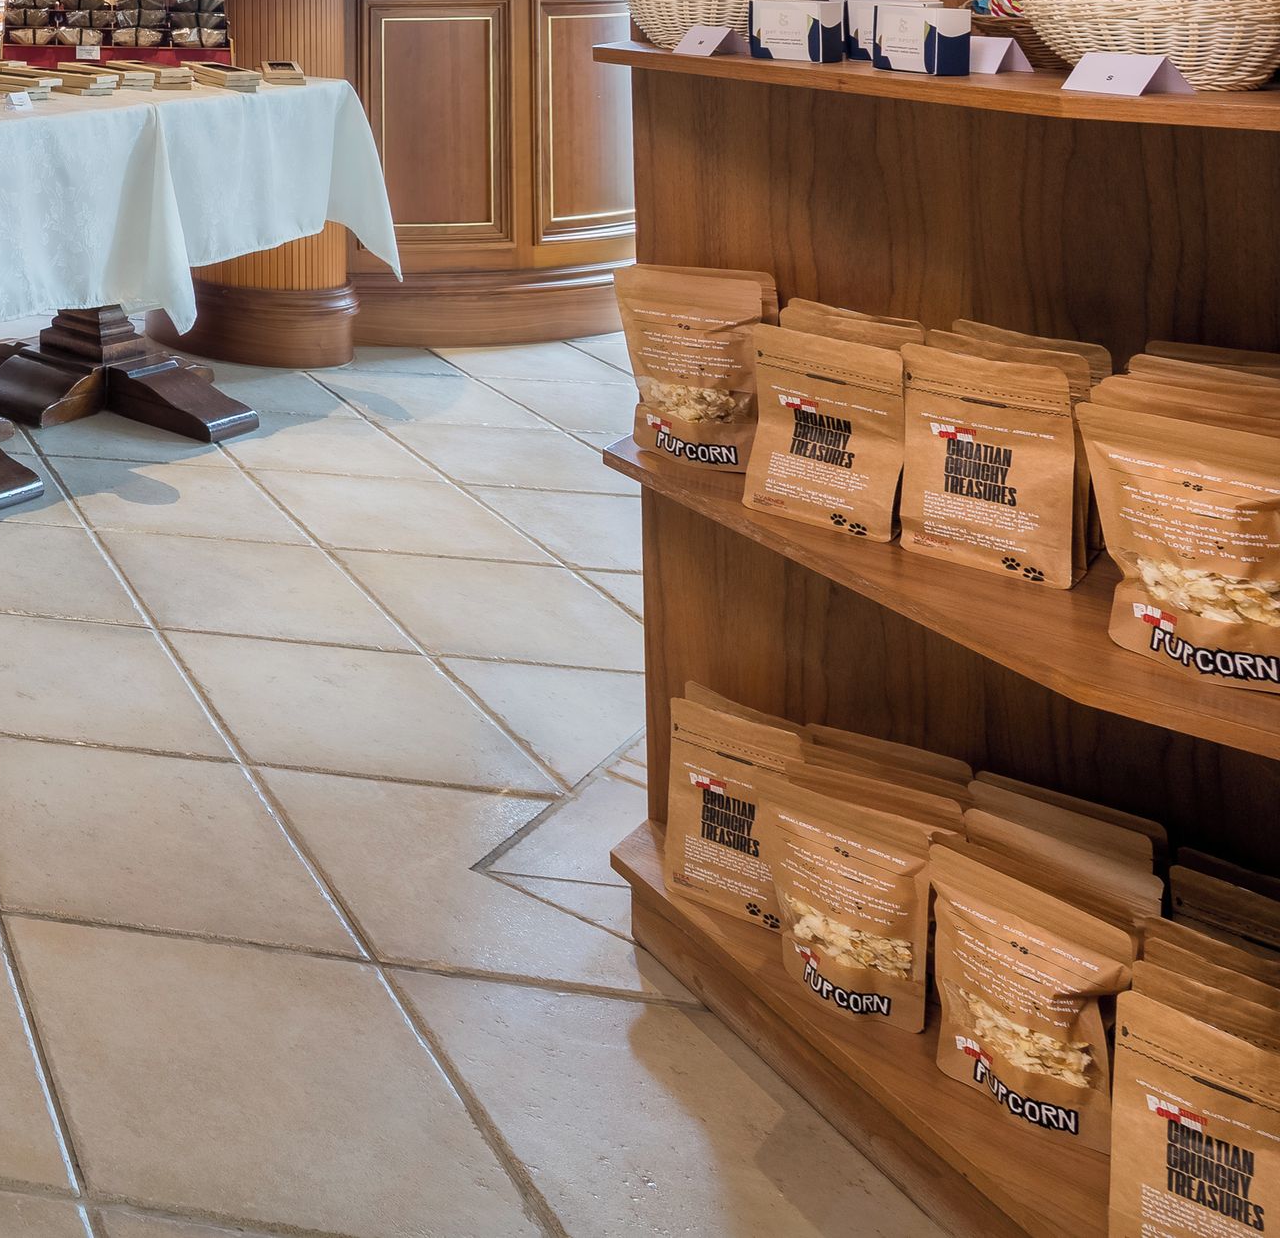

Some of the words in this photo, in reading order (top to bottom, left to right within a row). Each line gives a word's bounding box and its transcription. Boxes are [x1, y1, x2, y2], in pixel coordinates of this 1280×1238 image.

[793, 422, 850, 451] CRUNCHY
[794, 408, 852, 435] CROATIAN
[656, 431, 738, 465] PUPCORN
[790, 437, 855, 469] TREASURES
[946, 438, 1013, 468] CROATIAN
[944, 456, 1009, 485] CRUNCHY
[944, 473, 1017, 507] TREASURES
[1151, 627, 1279, 681] PUPCORN
[702, 788, 755, 821] CROATIAN
[702, 804, 754, 837] CRUNCHY
[701, 820, 759, 858] TREASURES
[804, 963, 889, 1015] PUPCORN
[975, 1061, 1076, 1133] PUPCORN
[1168, 1119, 1254, 1176] CROATIAN
[1167, 1142, 1253, 1200] CRUNCHY
[1166, 1165, 1264, 1232] TREASURES
